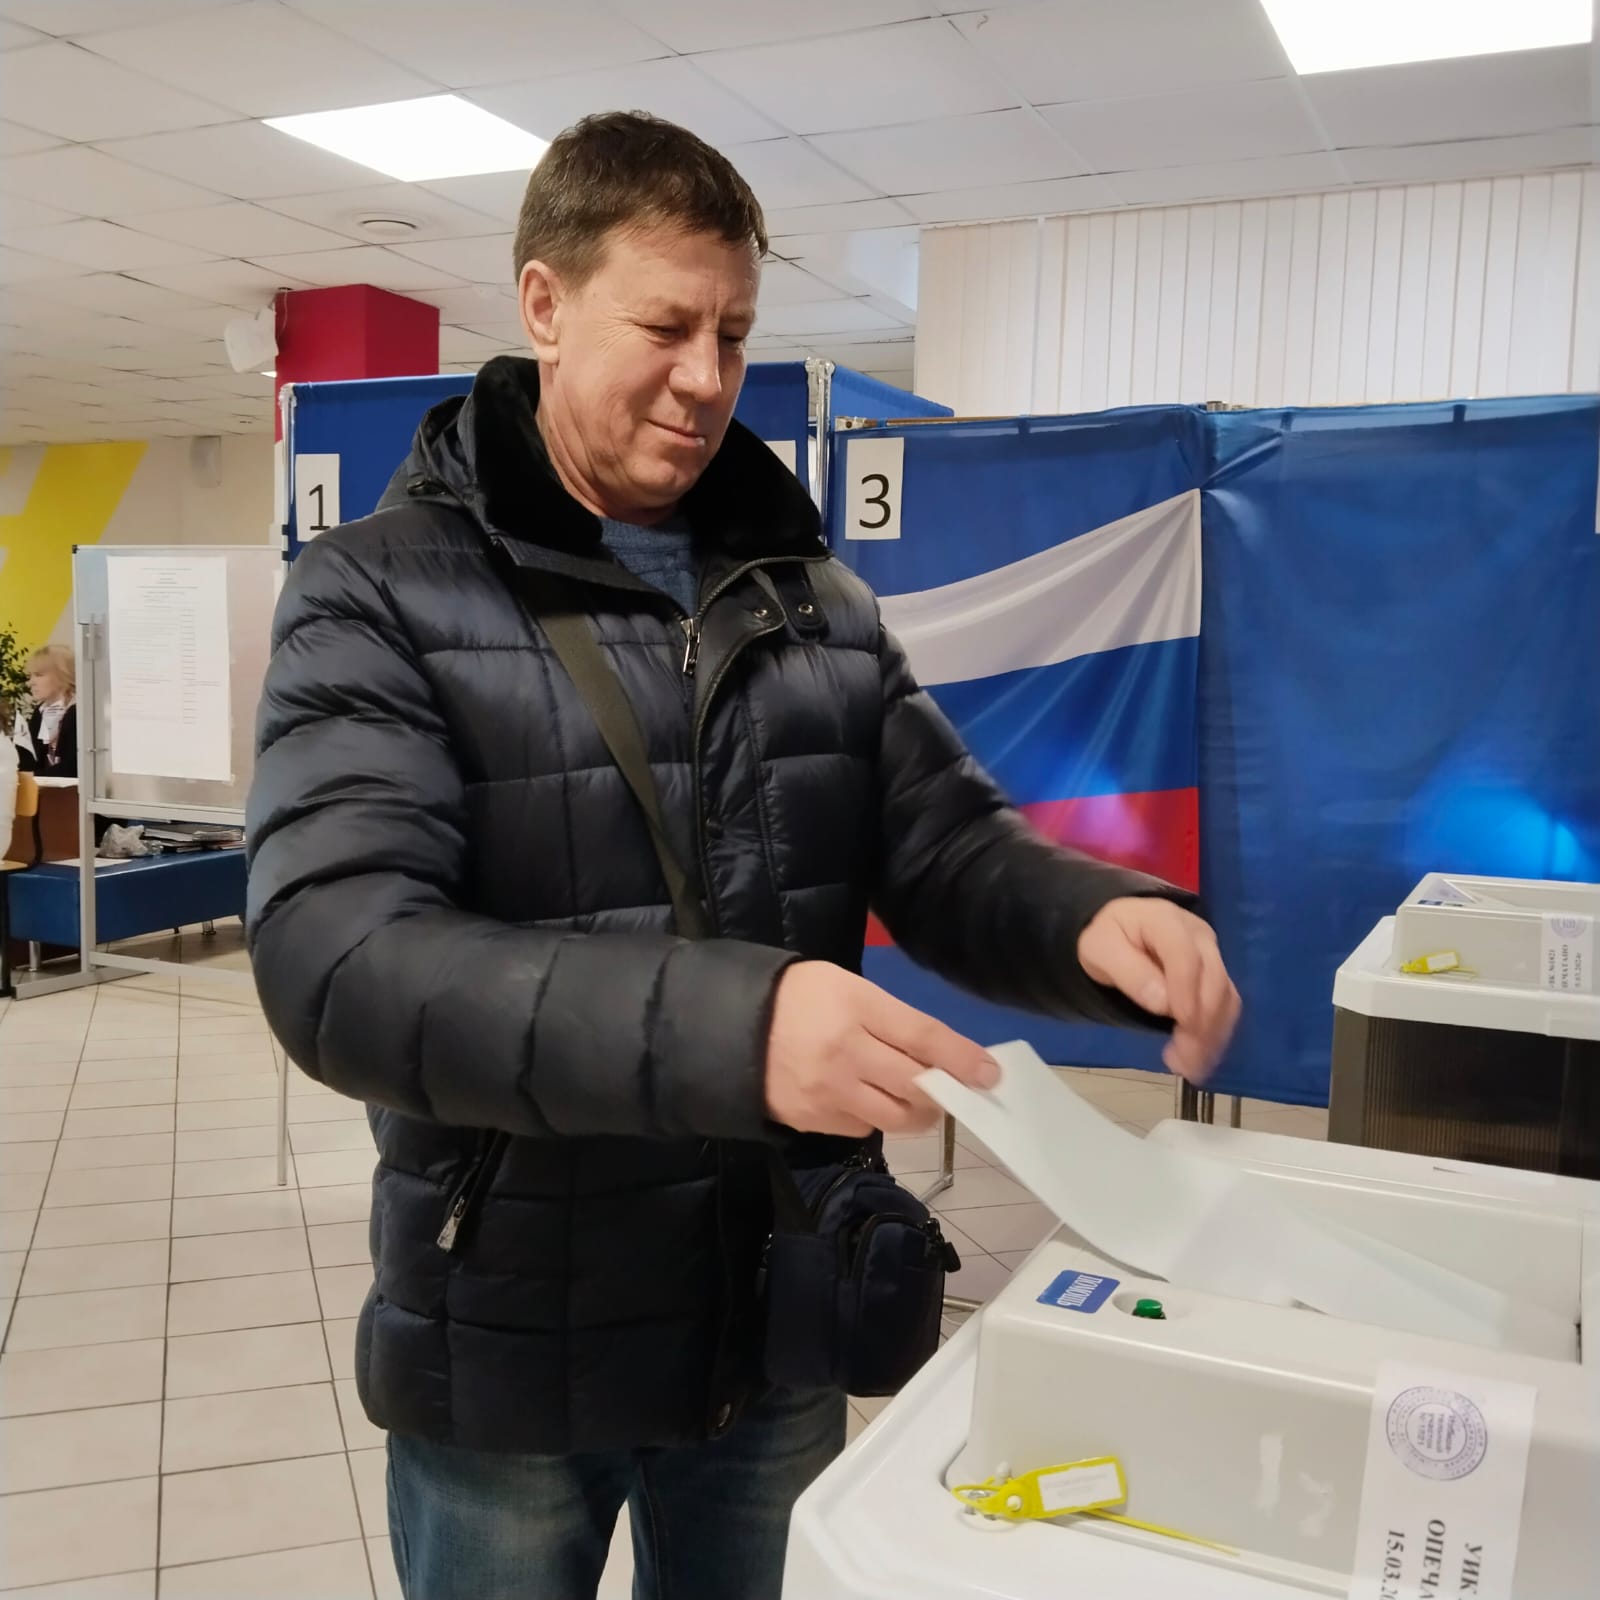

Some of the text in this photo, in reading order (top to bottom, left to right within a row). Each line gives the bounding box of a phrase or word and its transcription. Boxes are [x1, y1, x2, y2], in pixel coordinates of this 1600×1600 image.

[309, 484, 331, 531] 1
[859, 473, 891, 529] 3
[1056, 1274, 1104, 1307] ПОМОЩЬ
[1460, 1543, 1483, 1595] УИК
